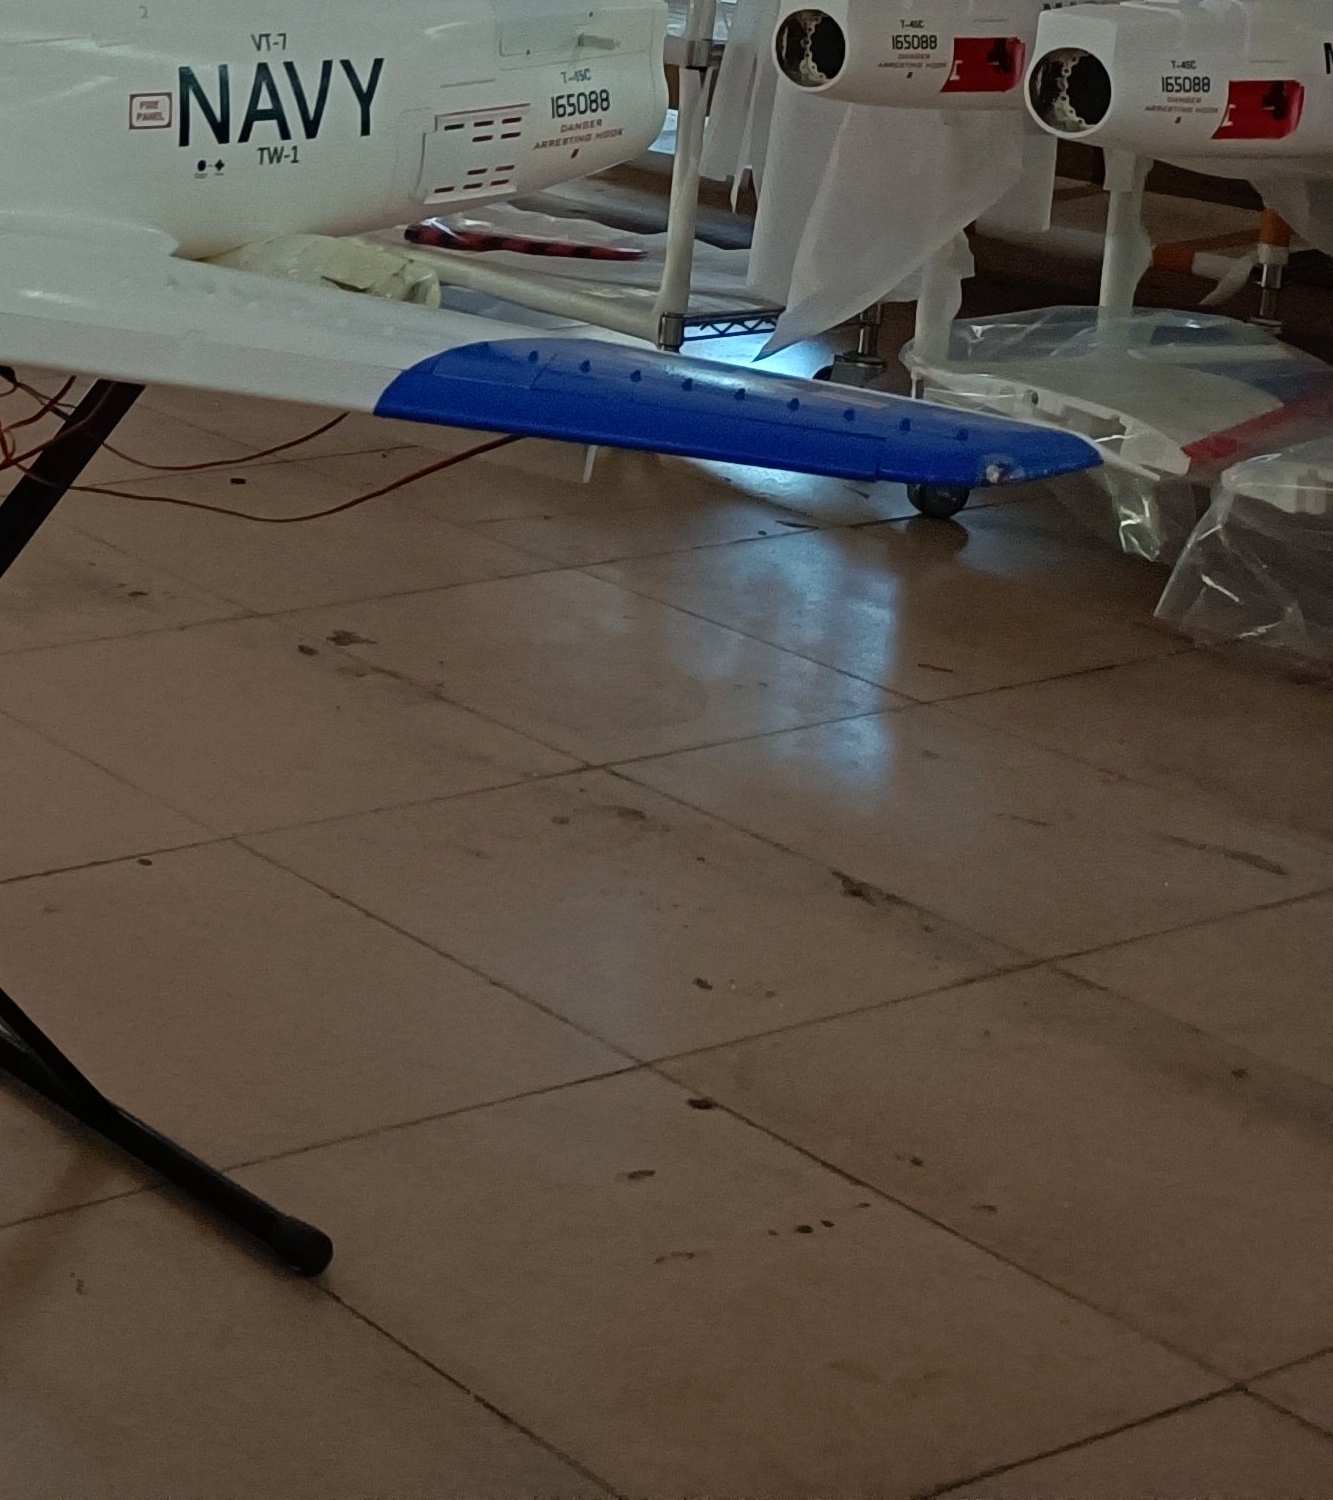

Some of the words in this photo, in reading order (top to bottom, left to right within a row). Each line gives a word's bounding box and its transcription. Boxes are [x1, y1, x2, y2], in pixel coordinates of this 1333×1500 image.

[250, 33, 287, 51] VT-7
[891, 34, 938, 50] 165088
[1161, 75, 1211, 93] 165088
[178, 58, 385, 147] NAVY
[550, 88, 611, 119] 165088
[533, 133, 592, 151] ARRESTING
[256, 145, 300, 165] TW-1
